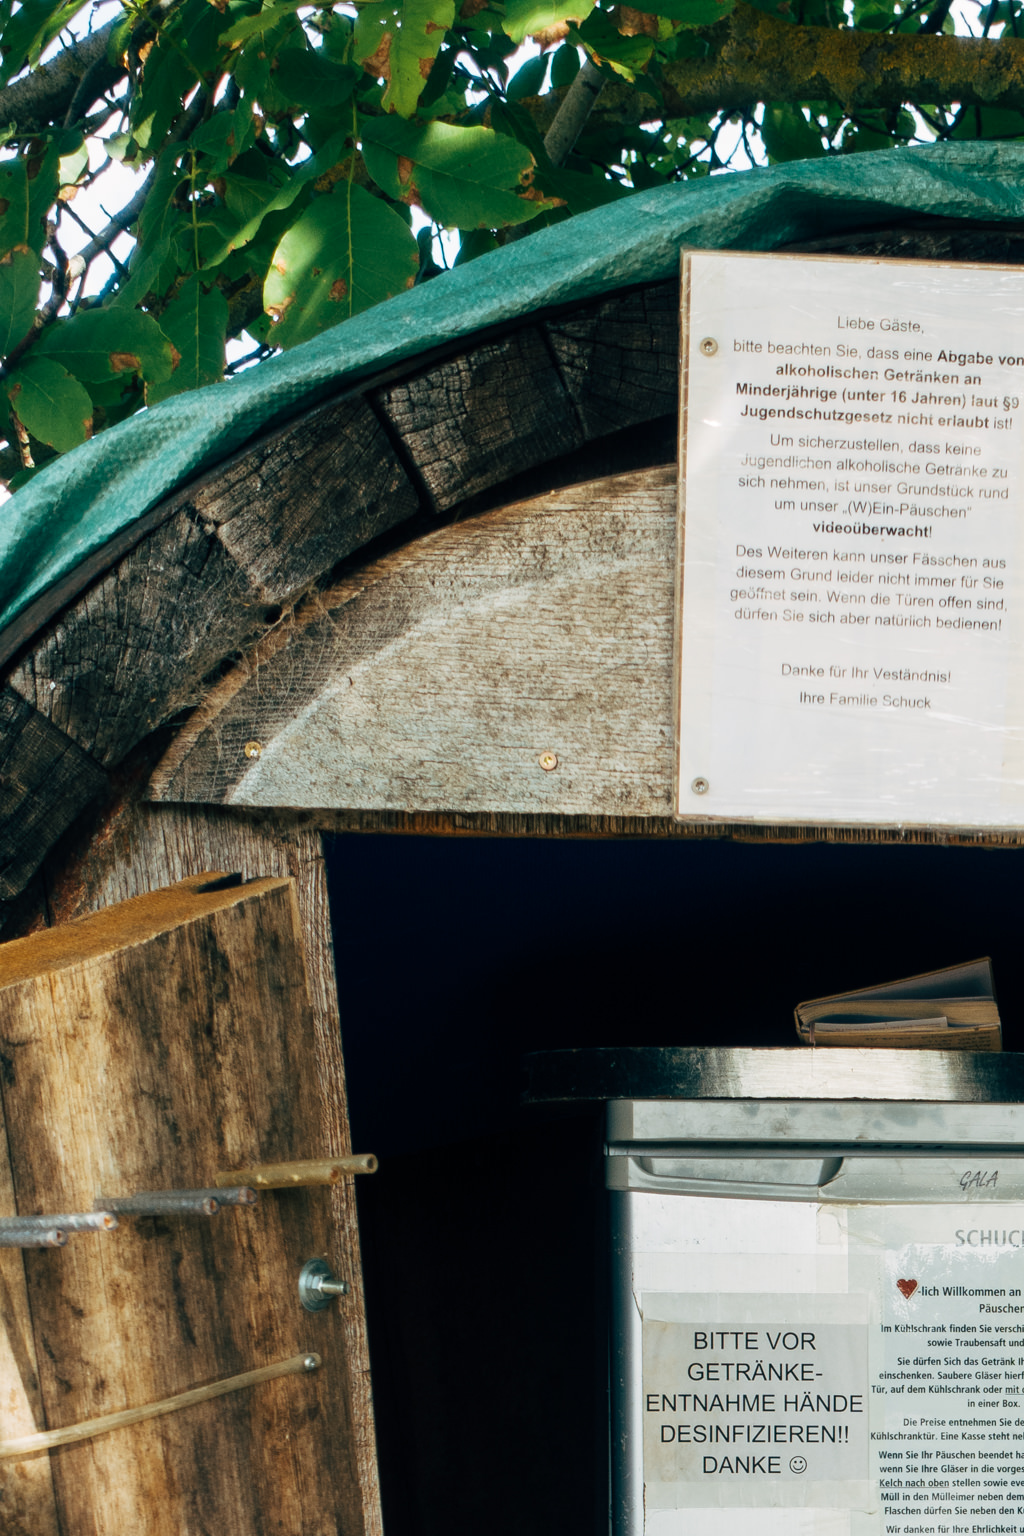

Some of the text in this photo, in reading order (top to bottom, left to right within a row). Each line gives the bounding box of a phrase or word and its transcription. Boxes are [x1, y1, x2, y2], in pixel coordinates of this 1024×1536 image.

[837, 315, 924, 334] Liebe Gäste,
[733, 338, 1024, 366] bitte beachten Sie, dass eine Abgabe von
[775, 363, 981, 385] alkoholischen Getränken an
[735, 382, 1019, 411] Minderjährige (unter 16 Jahren) laut §9
[740, 404, 1012, 429] Jugendschutzgesetz nicht erlaubt ist!
[812, 520, 931, 537] videoüberwacht!
[735, 544, 1006, 569] Des Weiteren kann unser Fässchen aus
[781, 662, 950, 682] Danke für Ihr Veständnis!
[799, 690, 931, 708] Ihre Familie Schuck
[960, 1170, 999, 1191] GALA
[942, 1286, 1005, 1296] Willkommen
[1008, 1288, 1021, 1296] an
[880, 1324, 891, 1332] Im
[894, 1323, 946, 1332] Kühlschrank
[948, 1323, 976, 1332] finden
[978, 1323, 992, 1332] Sie
[694, 1331, 815, 1350] BITTE VOR
[927, 1337, 952, 1346] sowie
[954, 1337, 1006, 1346] Traubensaft
[1008, 1338, 1024, 1346] und
[687, 1359, 822, 1381] GETRÄNKE-
[896, 1356, 910, 1365] Sie
[912, 1356, 941, 1365] dürfen
[943, 1356, 961, 1366] Sich
[963, 1356, 978, 1365] das
[980, 1356, 1015, 1366] Getränk
[646, 1391, 863, 1413] ENTNAHME HÄNDE
[967, 1398, 1020, 1407] in einer Box.
[903, 1417, 917, 1426] Die
[920, 1417, 946, 1426] Preise
[948, 1417, 996, 1426] entnehmen
[999, 1417, 1012, 1426] Sie
[660, 1424, 848, 1443] DESINFIZIEREN!!
[870, 1431, 937, 1440] Kühlschranktür.
[940, 1431, 958, 1440] Eine
[961, 1431, 985, 1440] Kasse
[988, 1431, 1010, 1440] steht
[703, 1455, 780, 1473] DANKE
